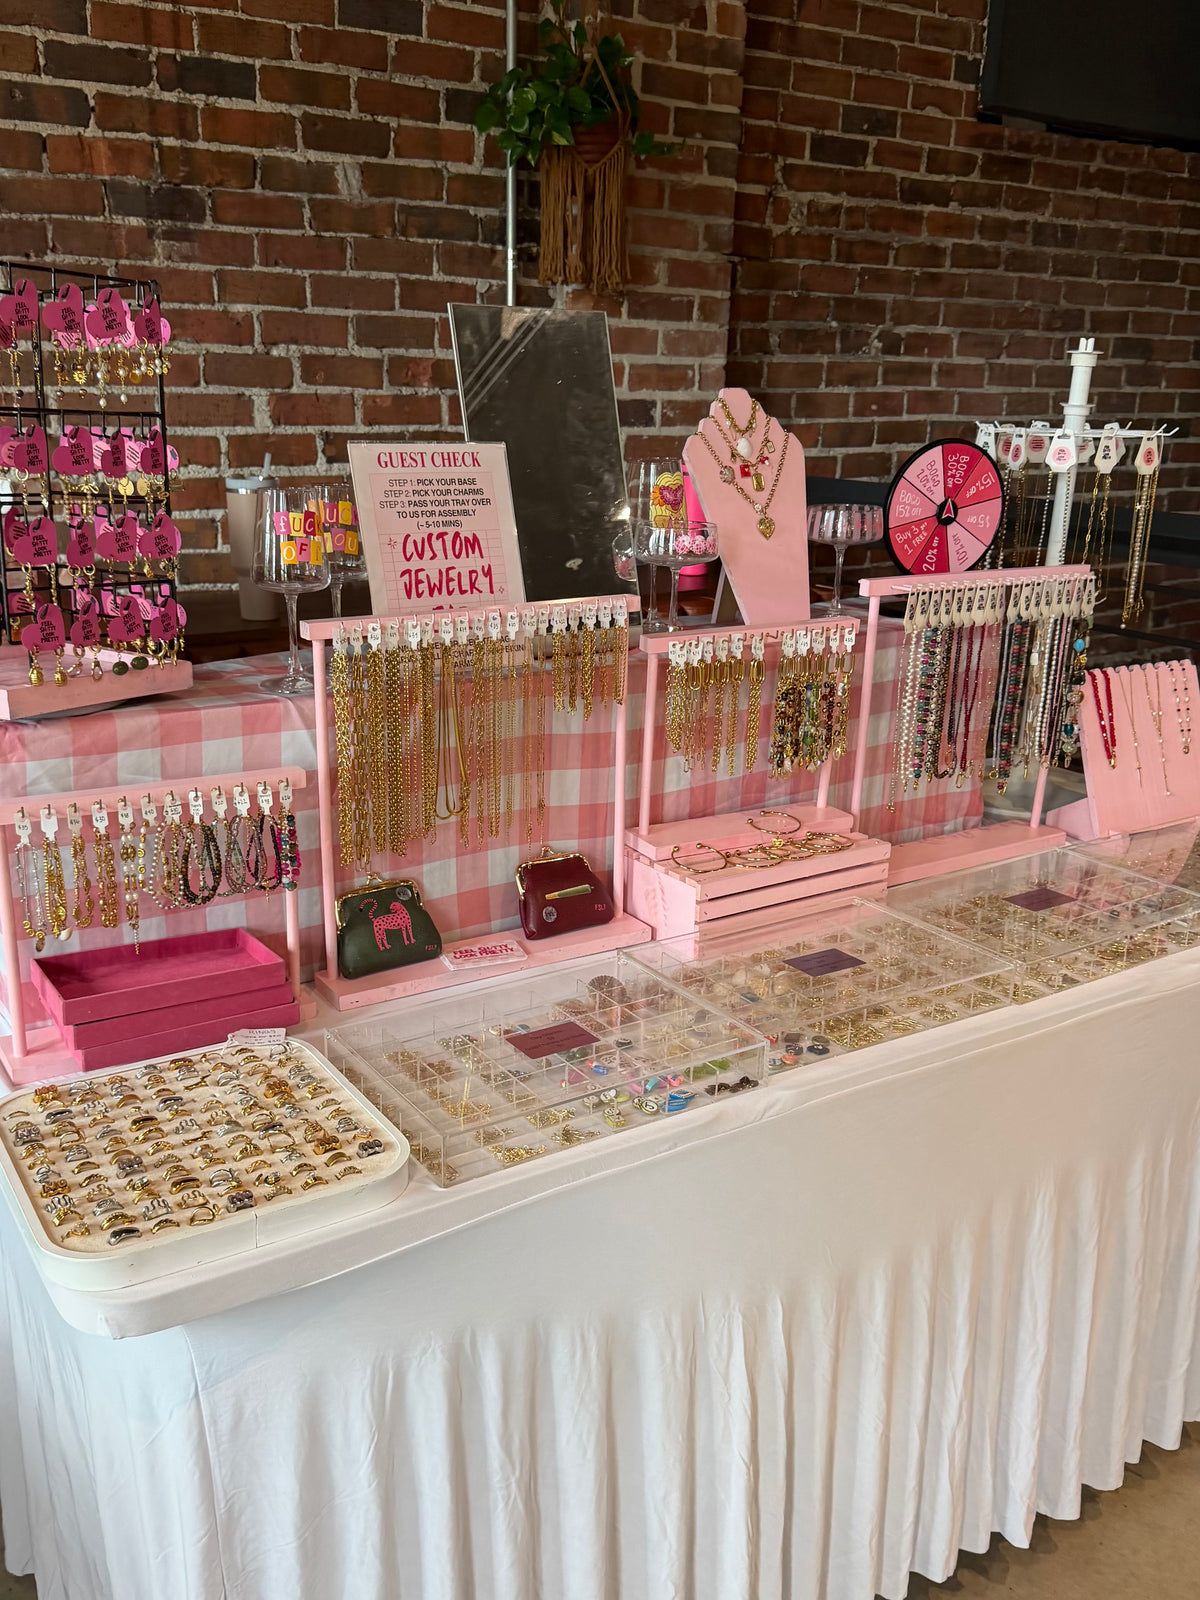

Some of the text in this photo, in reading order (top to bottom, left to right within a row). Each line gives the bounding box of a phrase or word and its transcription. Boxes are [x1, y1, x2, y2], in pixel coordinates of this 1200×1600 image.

[377, 451, 482, 468] GUEST CHECK
[948, 453, 960, 477] 30%
[954, 455, 970, 484] BOGO
[388, 479, 408, 487] STEP
[416, 478, 435, 486] PICK
[916, 468, 928, 488] 20%
[926, 459, 941, 488] BOGO
[412, 489, 431, 497] PICK
[453, 488, 484, 496] CHARMS
[966, 471, 996, 498] 15% OFF
[379, 500, 400, 508] STEP
[408, 500, 428, 508] PASS
[450, 499, 471, 507] TRAY
[472, 498, 492, 506] OVER
[895, 505, 911, 518] 15%
[396, 509, 476, 519] TO US FOR ASSEMBLY
[425, 520, 440, 529] 5-10
[441, 520, 463, 528] MINS)
[912, 526, 920, 535] 3
[402, 531, 484, 562] CUSTOM
[904, 531, 929, 555] 1 FREE
[922, 548, 938, 572] 20%
[400, 564, 495, 600] JEWELRY
